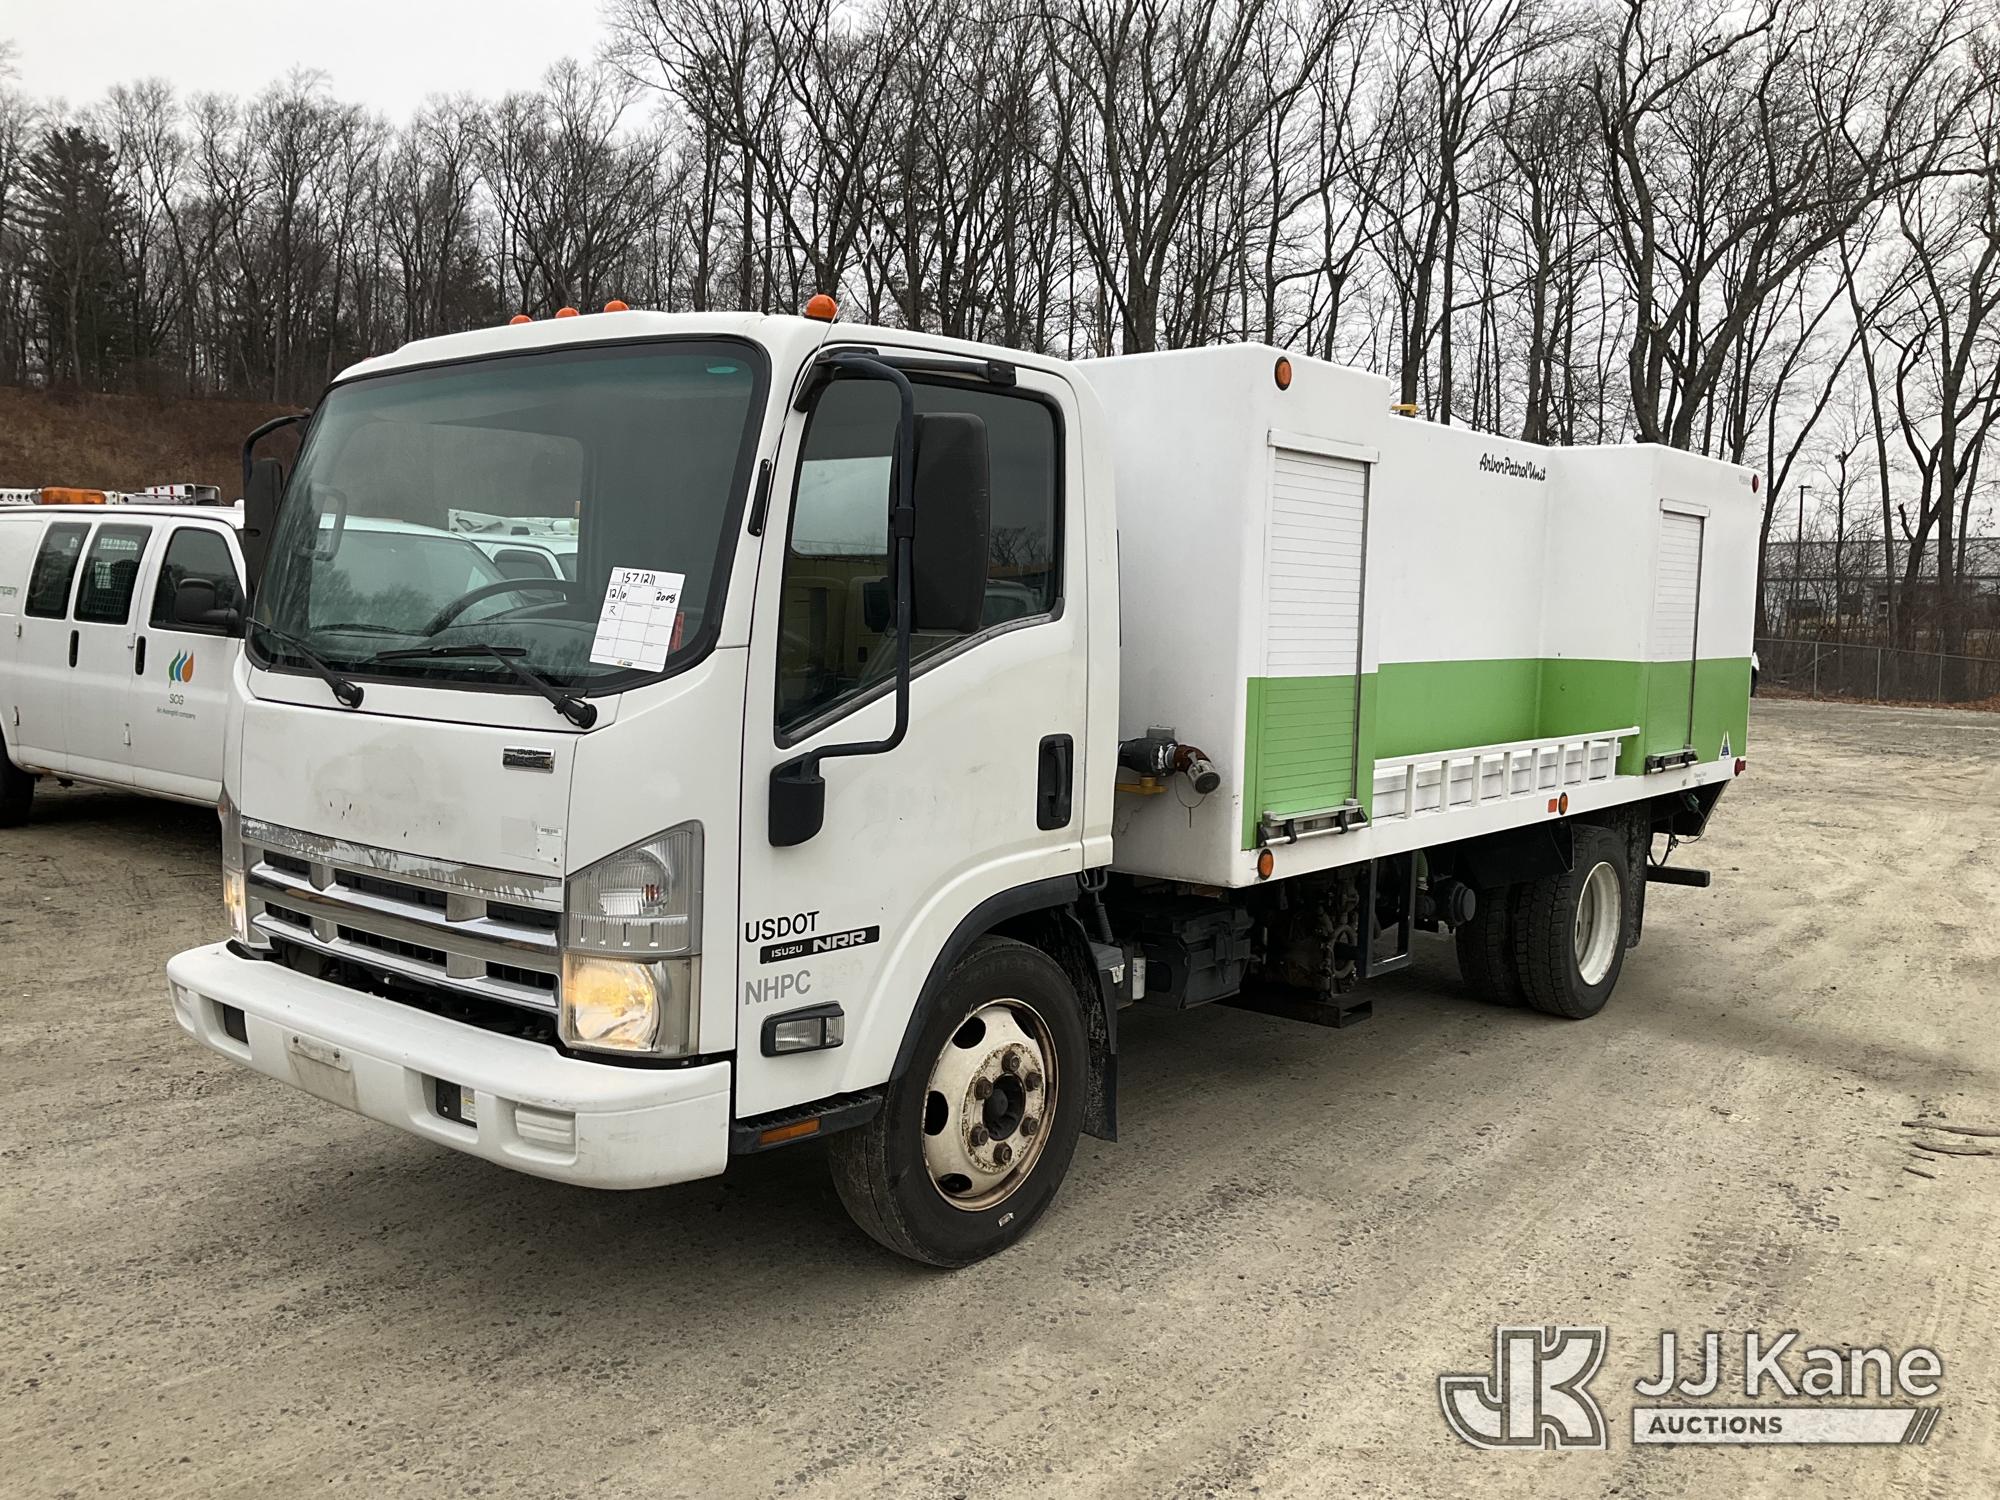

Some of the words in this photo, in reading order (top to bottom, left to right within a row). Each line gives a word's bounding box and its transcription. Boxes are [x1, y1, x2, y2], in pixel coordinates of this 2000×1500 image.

[745, 910, 820, 943] USDOT
[771, 944, 803, 958] ISUZU
[812, 930, 867, 953] NRR
[745, 969, 812, 1005] NHPC
